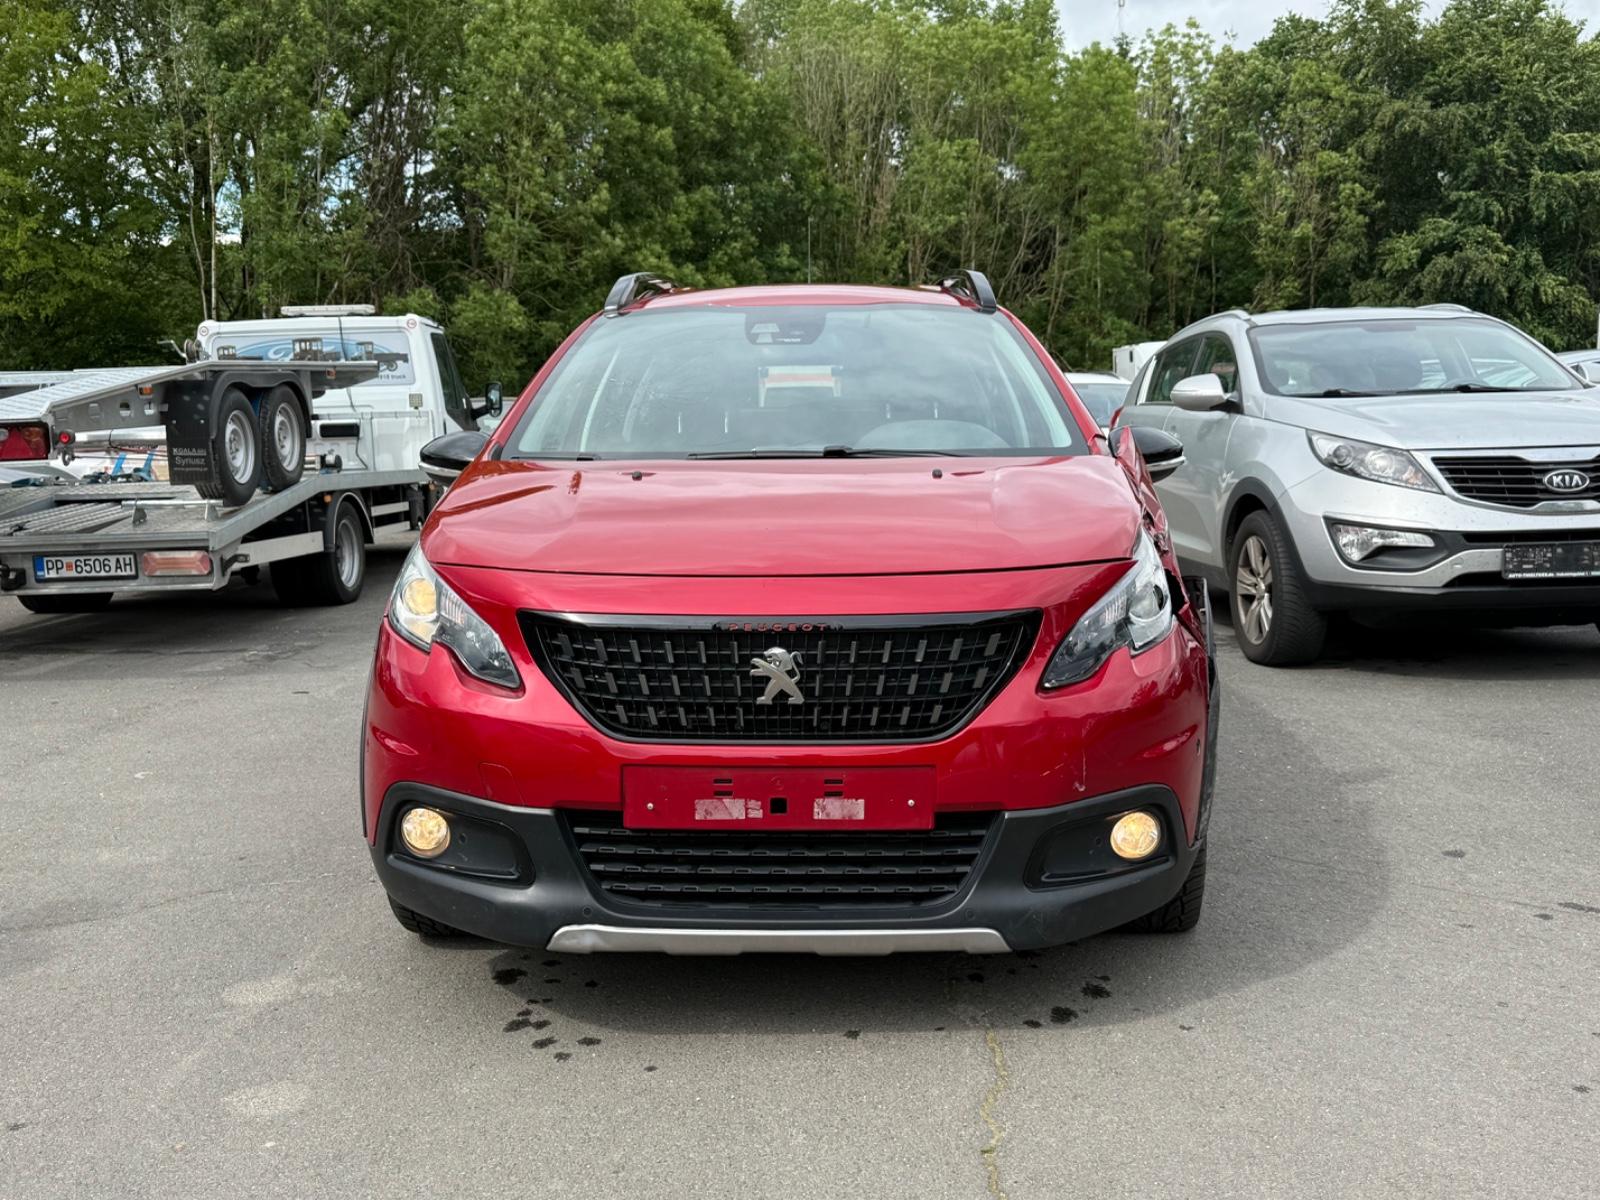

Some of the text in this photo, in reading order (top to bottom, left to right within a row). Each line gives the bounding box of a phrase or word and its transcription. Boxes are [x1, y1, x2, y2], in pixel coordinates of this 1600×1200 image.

[1552, 474, 1583, 487] KIA
[45, 557, 133, 576] PP 6506 AH
[728, 622, 827, 632] PEUGEOT
